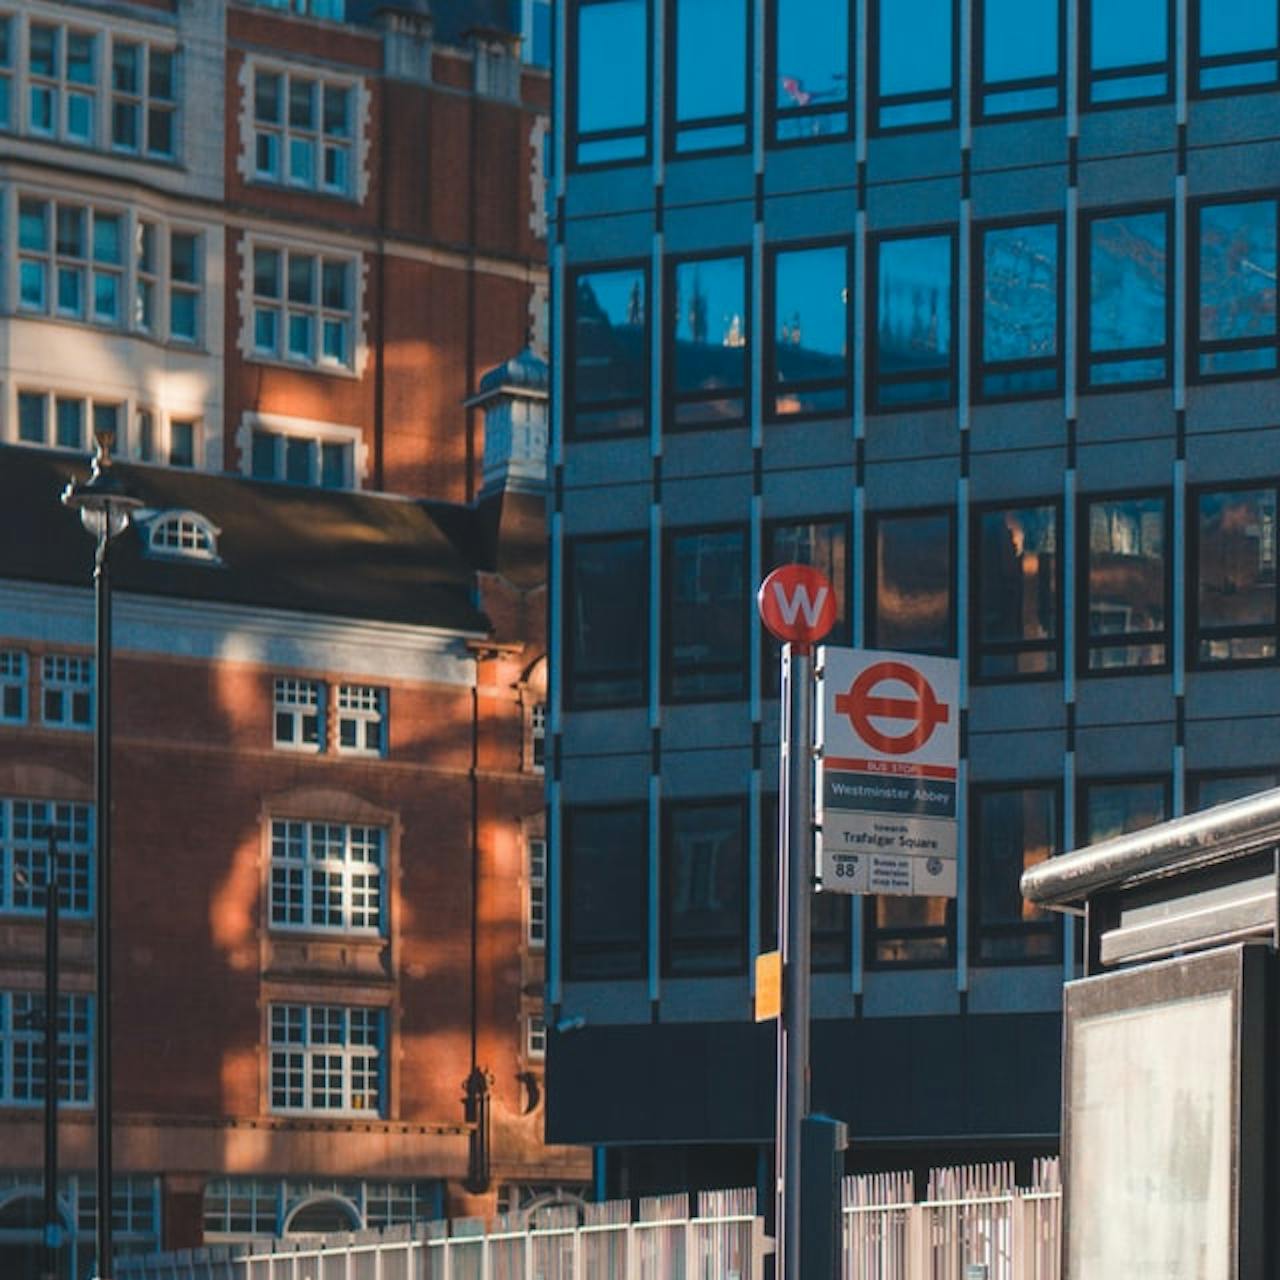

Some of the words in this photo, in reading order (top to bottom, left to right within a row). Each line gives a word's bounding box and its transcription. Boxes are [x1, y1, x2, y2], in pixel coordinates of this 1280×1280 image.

[772, 581, 829, 628] W
[866, 760, 888, 772] BUS
[831, 783, 910, 799] Westminster
[913, 788, 949, 805] Abbey
[843, 832, 896, 848] Trafalgar
[899, 836, 938, 849] Square
[835, 862, 855, 878] 88
